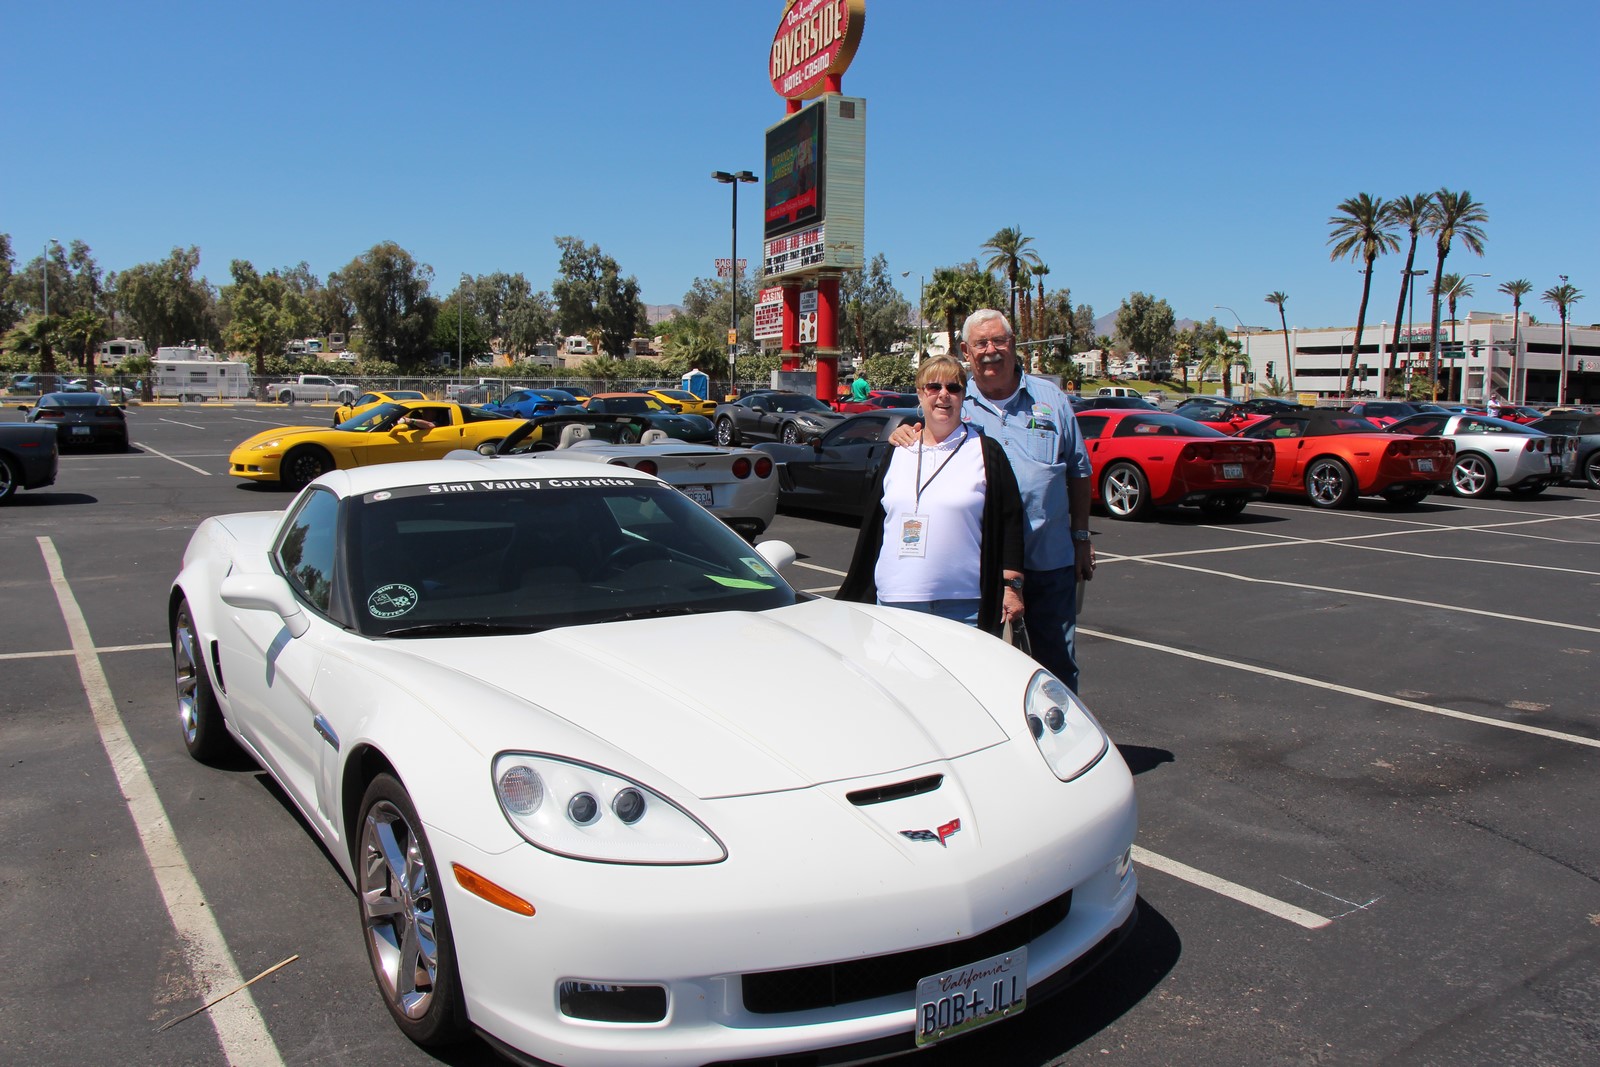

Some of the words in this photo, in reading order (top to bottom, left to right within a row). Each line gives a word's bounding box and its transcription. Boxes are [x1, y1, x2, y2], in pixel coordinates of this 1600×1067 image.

[773, 0, 842, 80] RIVERSIDE
[715, 258, 747, 268] CASNO
[428, 483, 475, 493] Simi
[481, 480, 541, 490] Valley
[548, 478, 635, 487] Corvettes
[377, 585, 393, 594] SIMI
[398, 585, 416, 599] VALLEY
[370, 604, 405, 617] CORVETTES
[942, 963, 1009, 992] California
